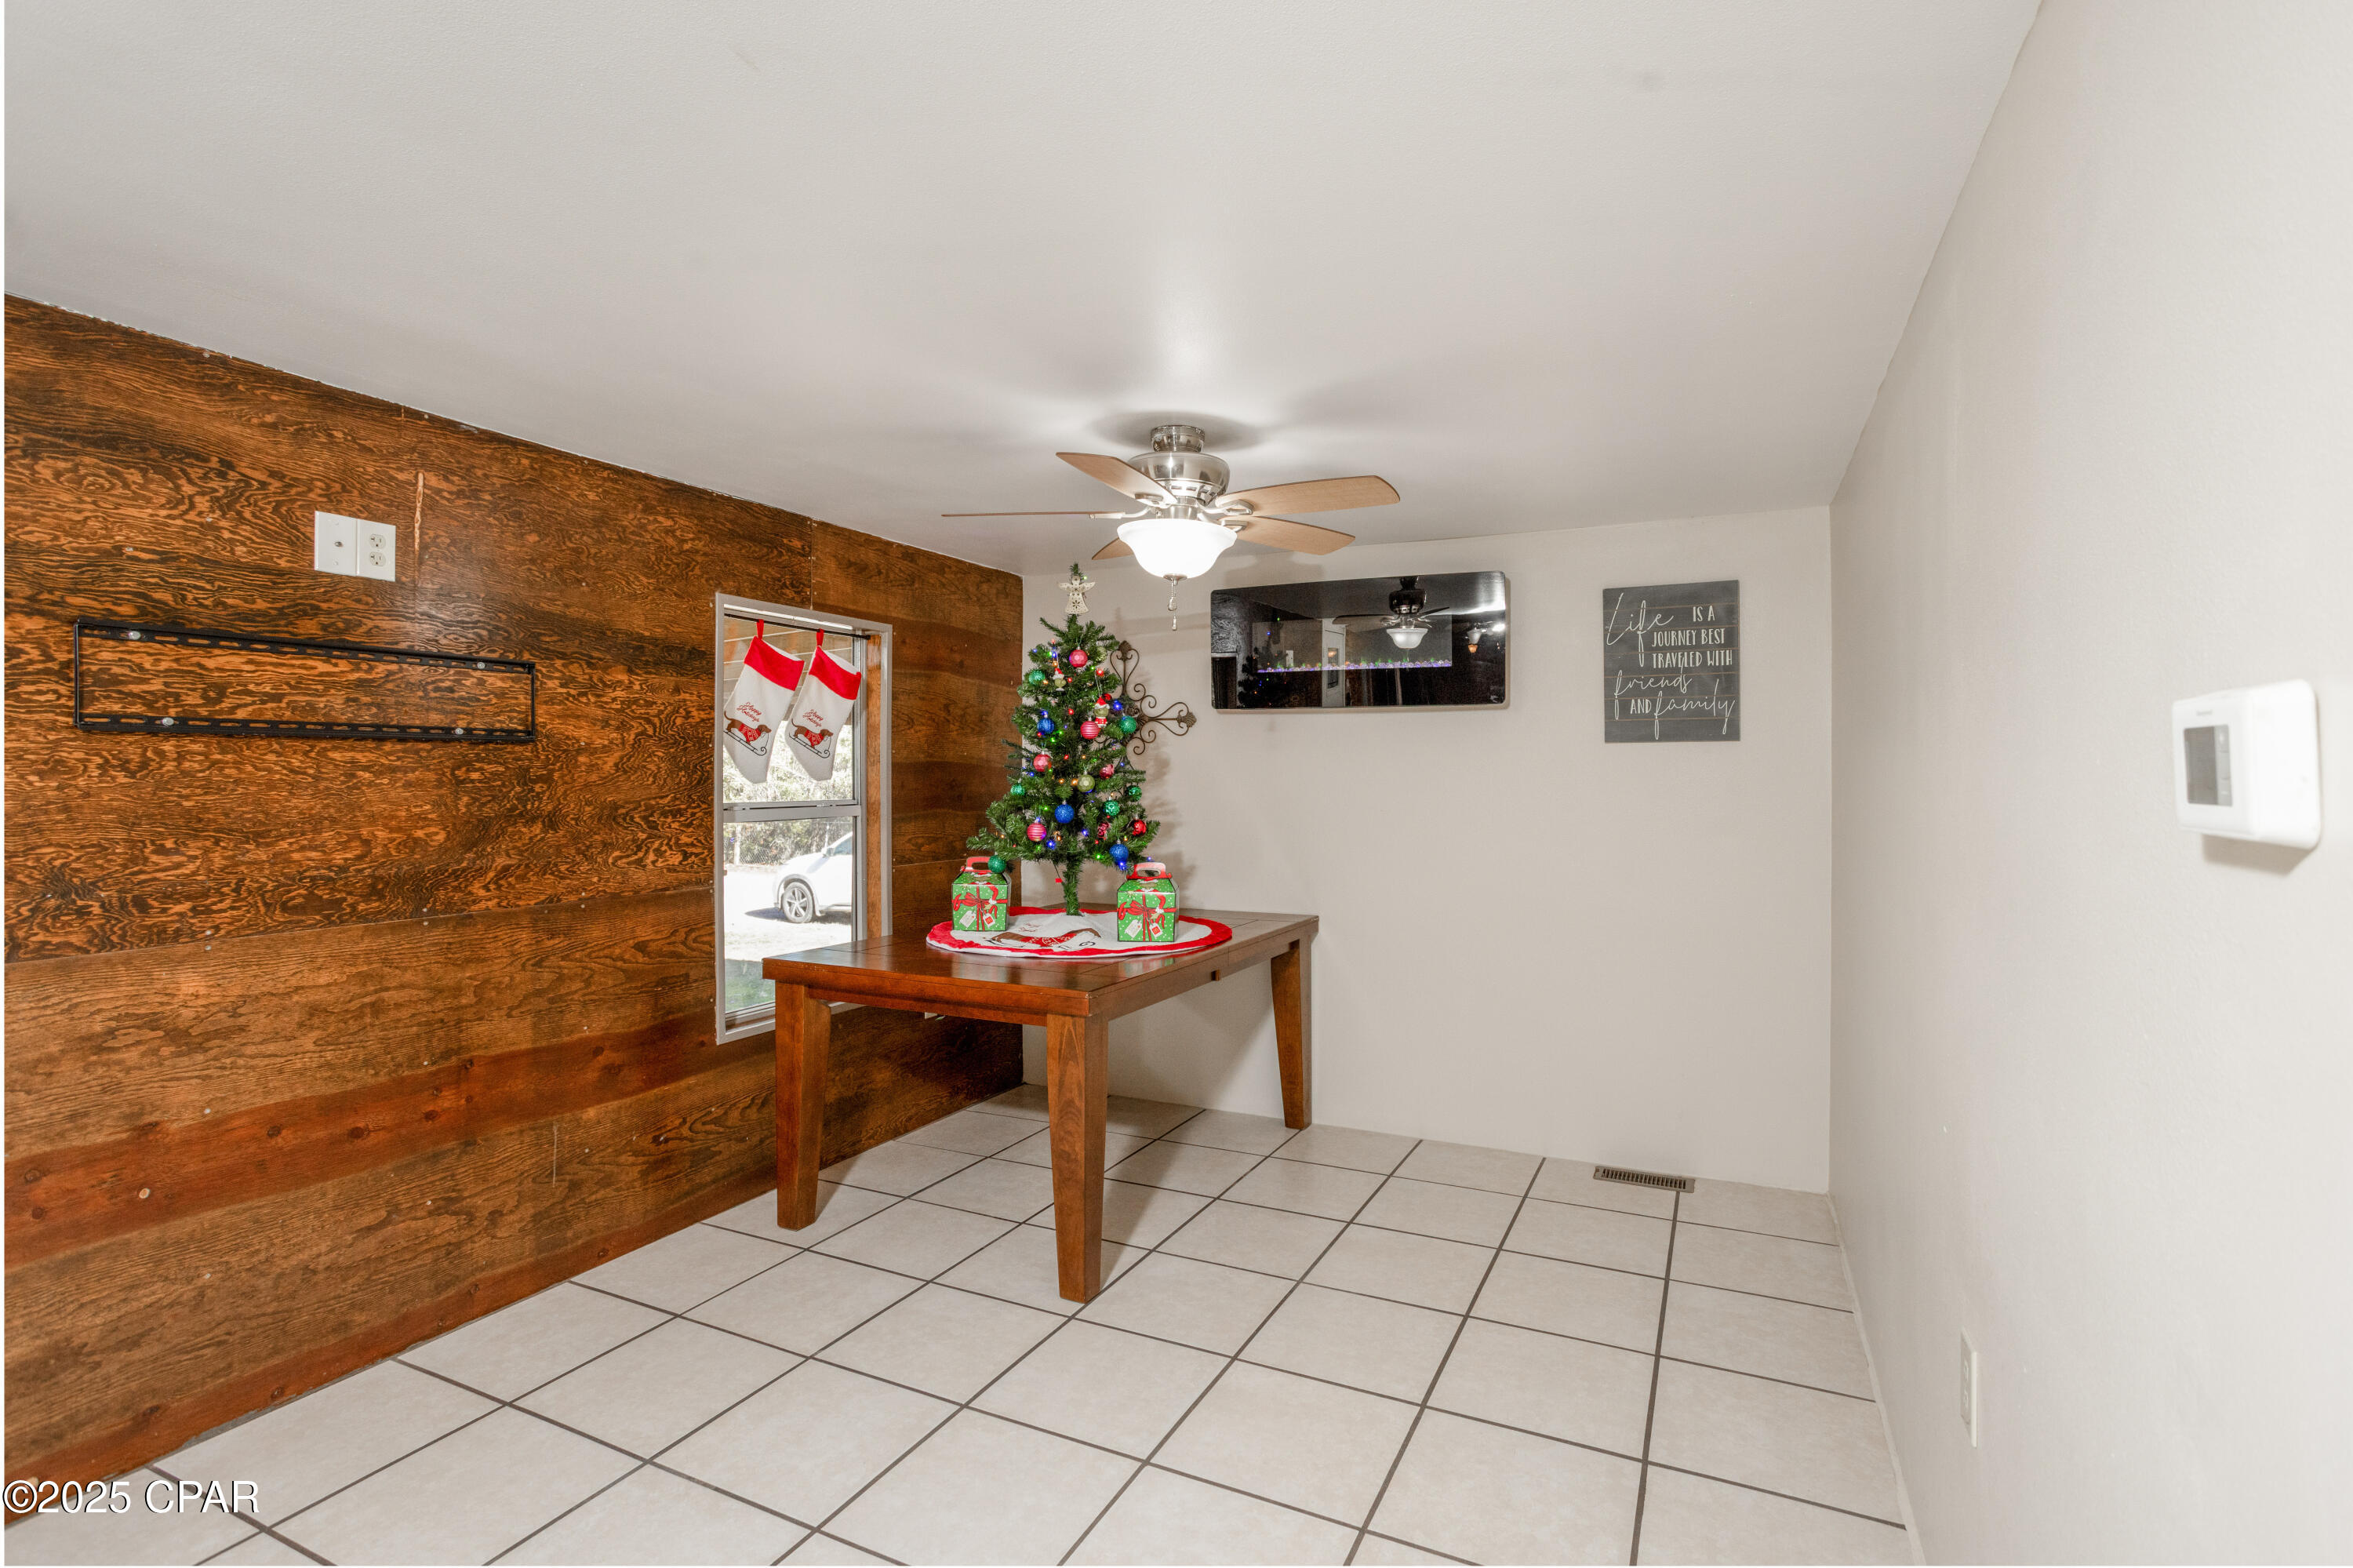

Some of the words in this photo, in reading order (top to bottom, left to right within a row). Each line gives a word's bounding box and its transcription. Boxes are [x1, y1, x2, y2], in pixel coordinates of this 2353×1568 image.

[1606, 592, 1674, 668] Life
[1693, 606, 1703, 622] IS
[1707, 605, 1715, 621] A
[1651, 629, 1697, 647] JOURNEY
[1701, 628, 1726, 645] BEST
[1652, 651, 1703, 669] TRAVELED
[1707, 649, 1733, 667] WITH
[1613, 657, 1693, 721] friends
[1630, 698, 1652, 715] AND
[1653, 678, 1736, 740] family
